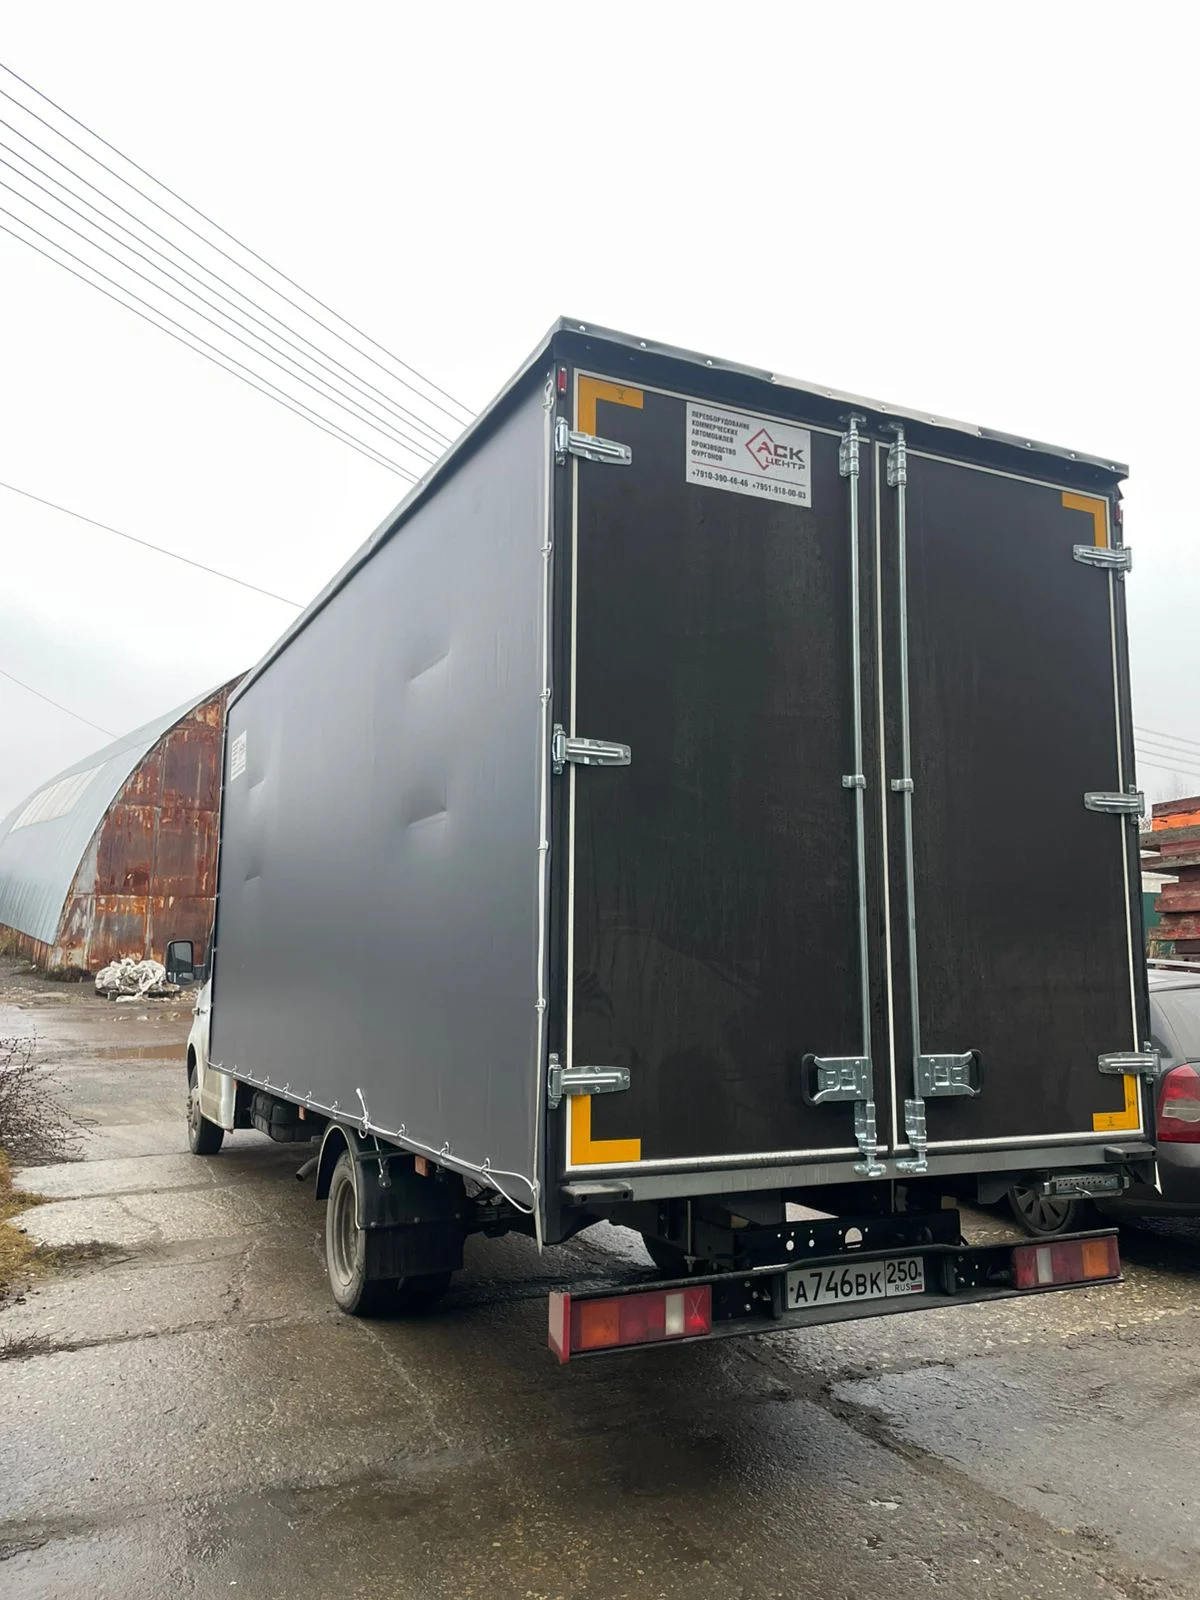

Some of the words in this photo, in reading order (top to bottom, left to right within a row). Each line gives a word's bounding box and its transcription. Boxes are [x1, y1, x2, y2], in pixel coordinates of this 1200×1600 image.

[691, 410, 750, 430] ПЕРЕОБОРУДОВАНИЕ
[691, 420, 738, 436] КОММЕРЧЕСКИХ
[691, 440, 737, 456] ПРОИЗВОДСТВО
[691, 449, 723, 461] ФУРГОНОВ
[756, 441, 805, 463] АСК
[765, 457, 806, 471] ЦЕНТР
[886, 1260, 918, 1284] 250
[894, 1283, 911, 1292] RUS
